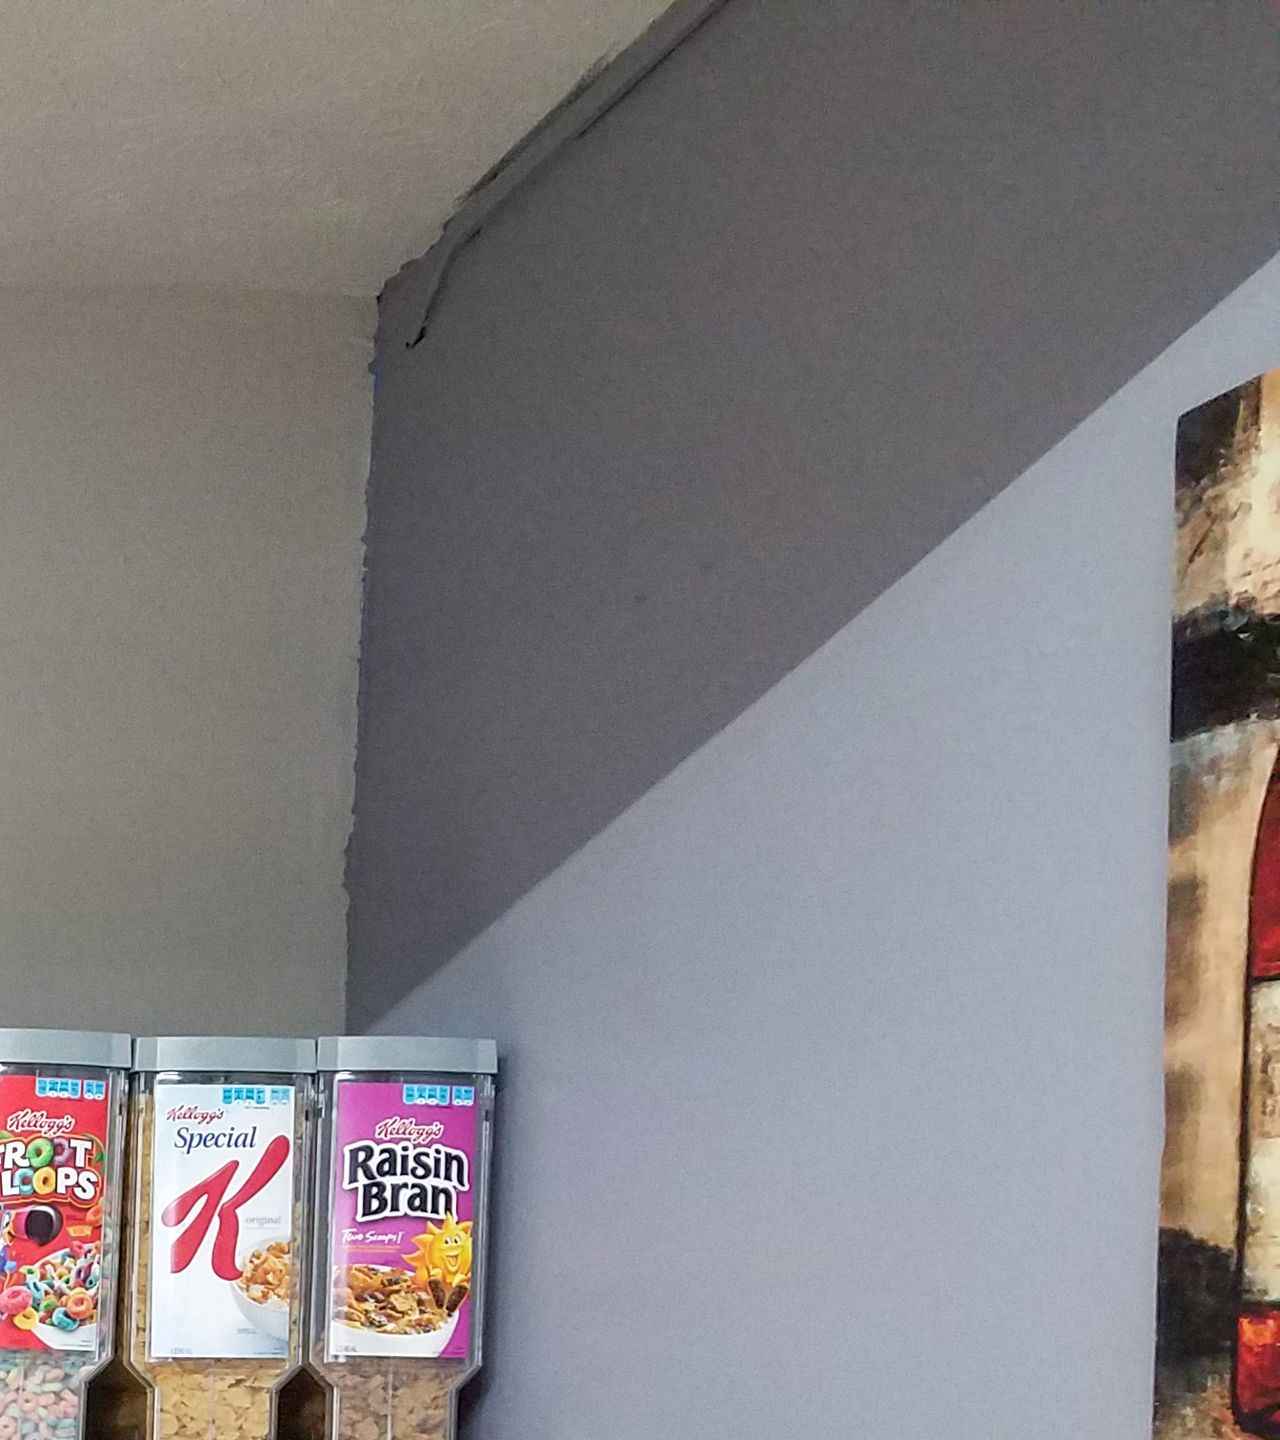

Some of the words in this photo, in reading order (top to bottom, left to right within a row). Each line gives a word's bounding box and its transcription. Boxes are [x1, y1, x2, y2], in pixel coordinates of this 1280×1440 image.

[8, 1109, 74, 1135] Kellogg's
[167, 1104, 225, 1125] Kellogg's
[174, 1125, 258, 1155] Special
[377, 1118, 443, 1142] Kellogg's
[347, 1144, 466, 1188] Raisin
[1, 1165, 98, 1200] LOOPS
[161, 1134, 291, 1281] K
[360, 1180, 454, 1218] Bran
[244, 1216, 281, 1227] original
[341, 1228, 364, 1244] Two
